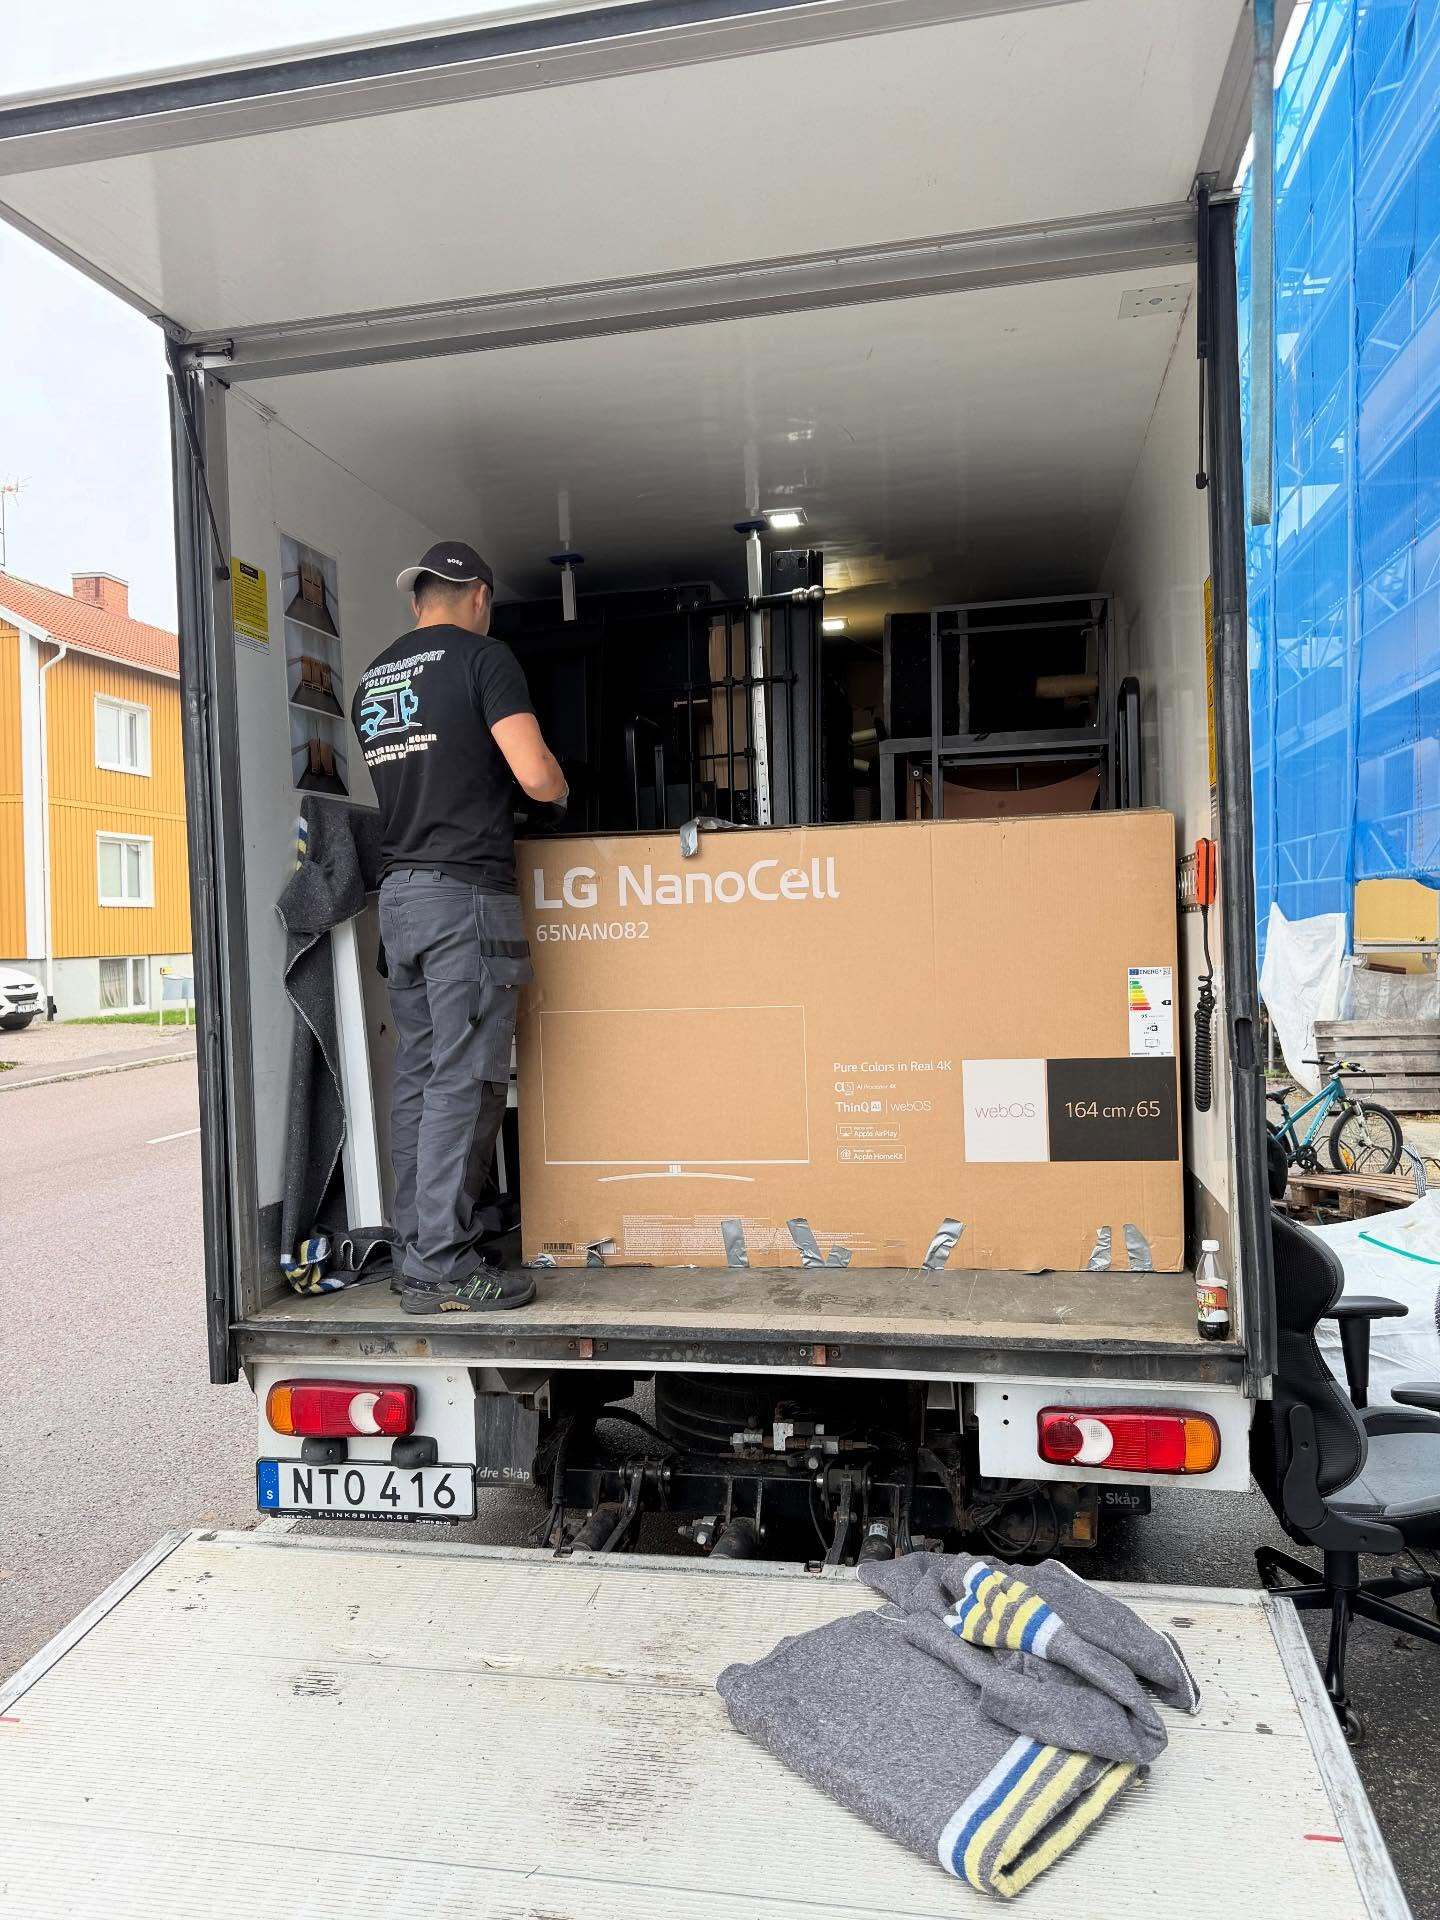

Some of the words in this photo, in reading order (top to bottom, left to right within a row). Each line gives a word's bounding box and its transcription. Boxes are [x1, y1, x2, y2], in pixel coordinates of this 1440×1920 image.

[365, 669, 412, 690] SOLUTIONS
[533, 866, 598, 909] LG
[618, 856, 840, 907] NanoCell
[535, 921, 650, 942] 65NANO82
[833, 1062, 858, 1073] Pure
[860, 1061, 896, 1072] Colors
[898, 1060, 908, 1071] in
[910, 1060, 934, 1071] Real
[936, 1060, 952, 1071] 4K
[835, 1101, 869, 1113] ThinQ
[890, 1100, 932, 1112] webOS
[974, 1102, 1036, 1119] webOS
[1065, 1102, 1099, 1118] 164
[502, 1467, 530, 1483] Skåp
[266, 1489, 274, 1500] S
[292, 1467, 365, 1505] NTO
[379, 1471, 456, 1509] 416
[1105, 1492, 1140, 1509] Skåp
